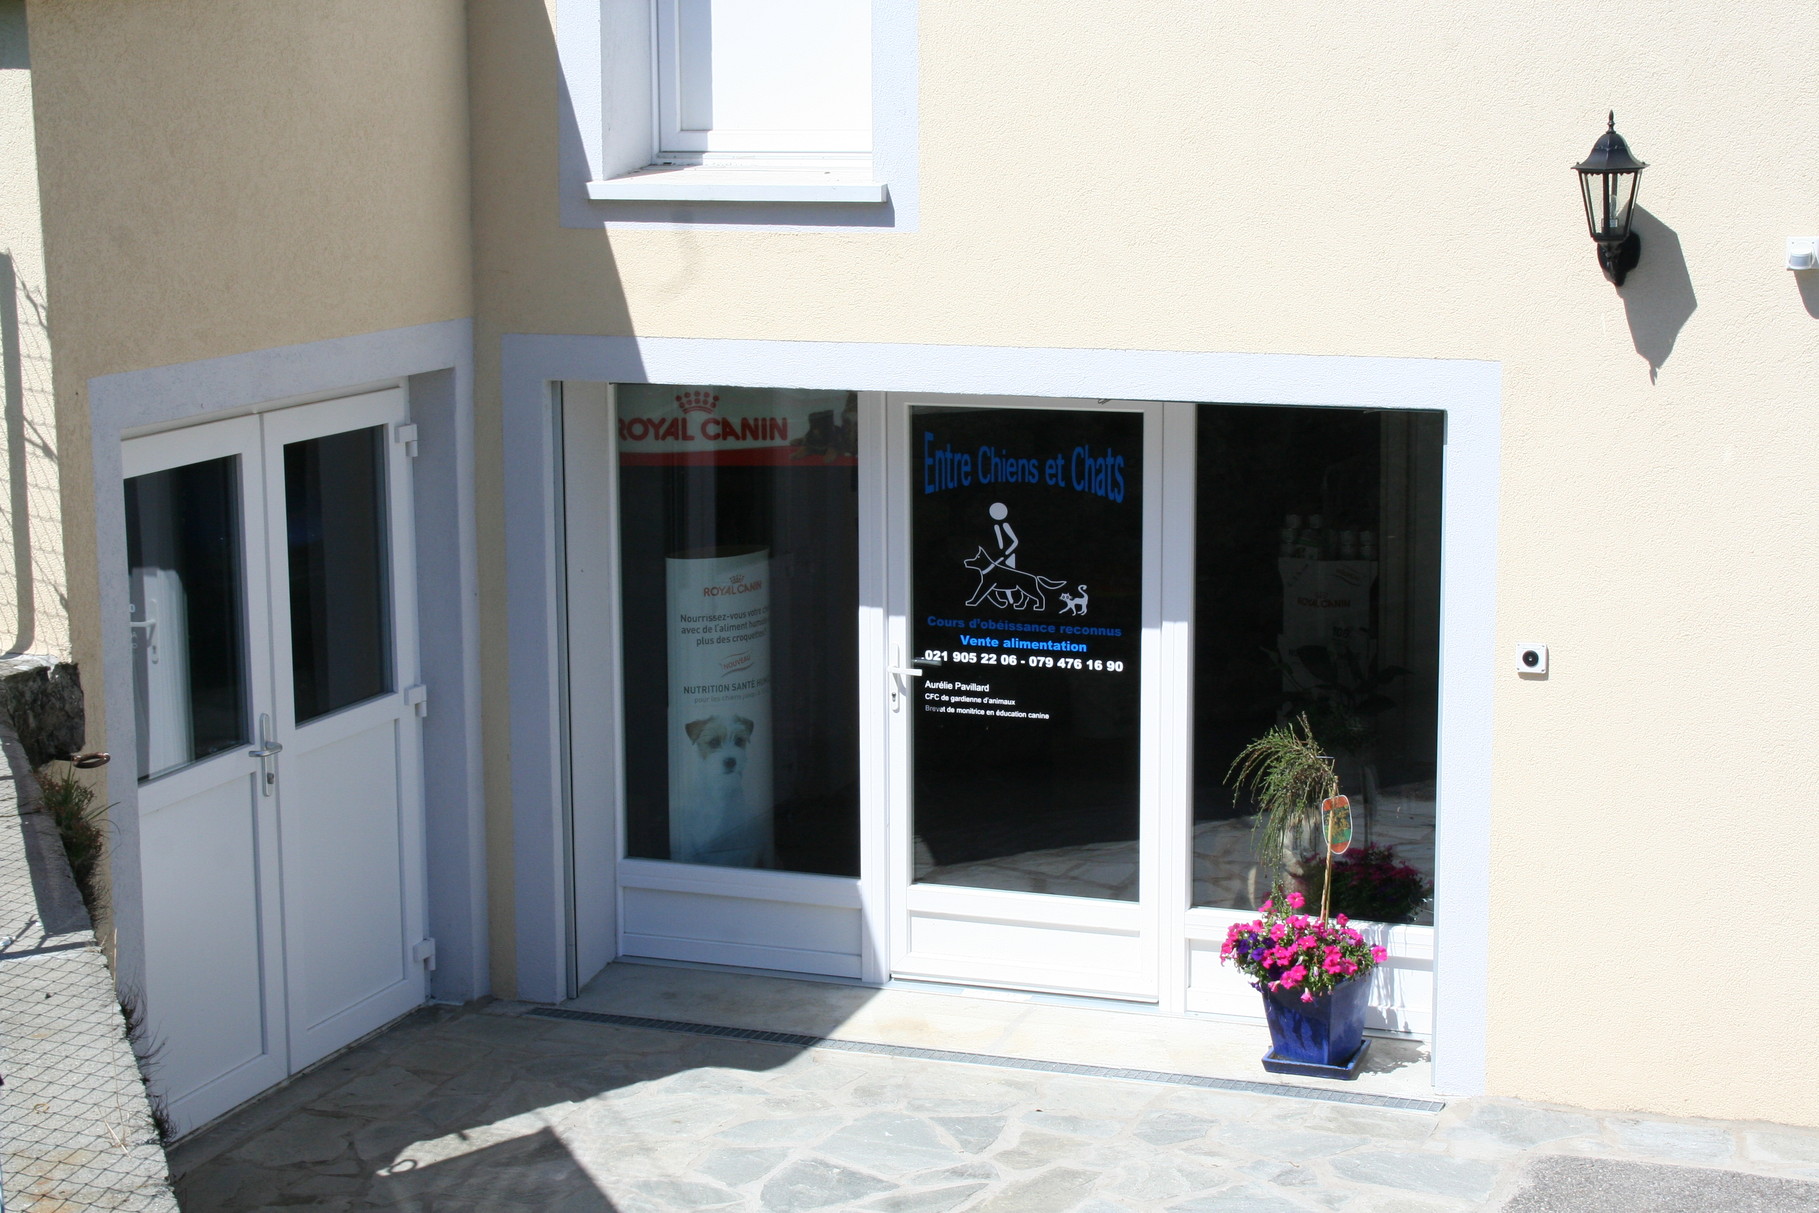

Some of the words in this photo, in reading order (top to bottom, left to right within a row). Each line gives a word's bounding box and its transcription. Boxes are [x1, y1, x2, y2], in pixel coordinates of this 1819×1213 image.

[618, 417, 695, 441] ROYAL
[701, 416, 788, 441] CANIN
[924, 431, 971, 495] Entre
[978, 445, 1039, 484] Chiens
[1045, 453, 1065, 487] et
[1071, 444, 1124, 503] Chats
[703, 585, 736, 597] ROYAL
[680, 611, 747, 623] Nourrissez-vous
[681, 625, 700, 634] avec
[702, 624, 713, 634] de
[714, 621, 748, 633] l'aliment
[927, 616, 965, 629] Cours
[969, 618, 1056, 634] d'obéissance
[1059, 625, 1122, 637] reconnus
[696, 635, 714, 647] plus
[716, 633, 731, 644] des
[960, 635, 999, 648] Vente
[1002, 637, 1088, 653] alimentation
[925, 650, 948, 662] 021
[952, 651, 977, 664] 905
[980, 653, 997, 665] 22
[1000, 654, 1017, 666] 06
[1028, 656, 1054, 668] 079
[1057, 658, 1083, 670] 476
[1086, 659, 1103, 671] 16
[1106, 660, 1124, 672] 90
[683, 683, 730, 695] NUTRITION
[924, 680, 953, 690] Aurélie
[955, 681, 990, 692] Pavillard
[924, 692, 940, 701] CFC
[950, 695, 982, 704] gardienne
[982, 696, 1016, 706] d'animaux
[946, 706, 955, 714] de
[956, 706, 985, 716] monitrice
[986, 709, 995, 717] en
[995, 709, 1027, 719] éducation
[1028, 712, 1050, 720] canine
